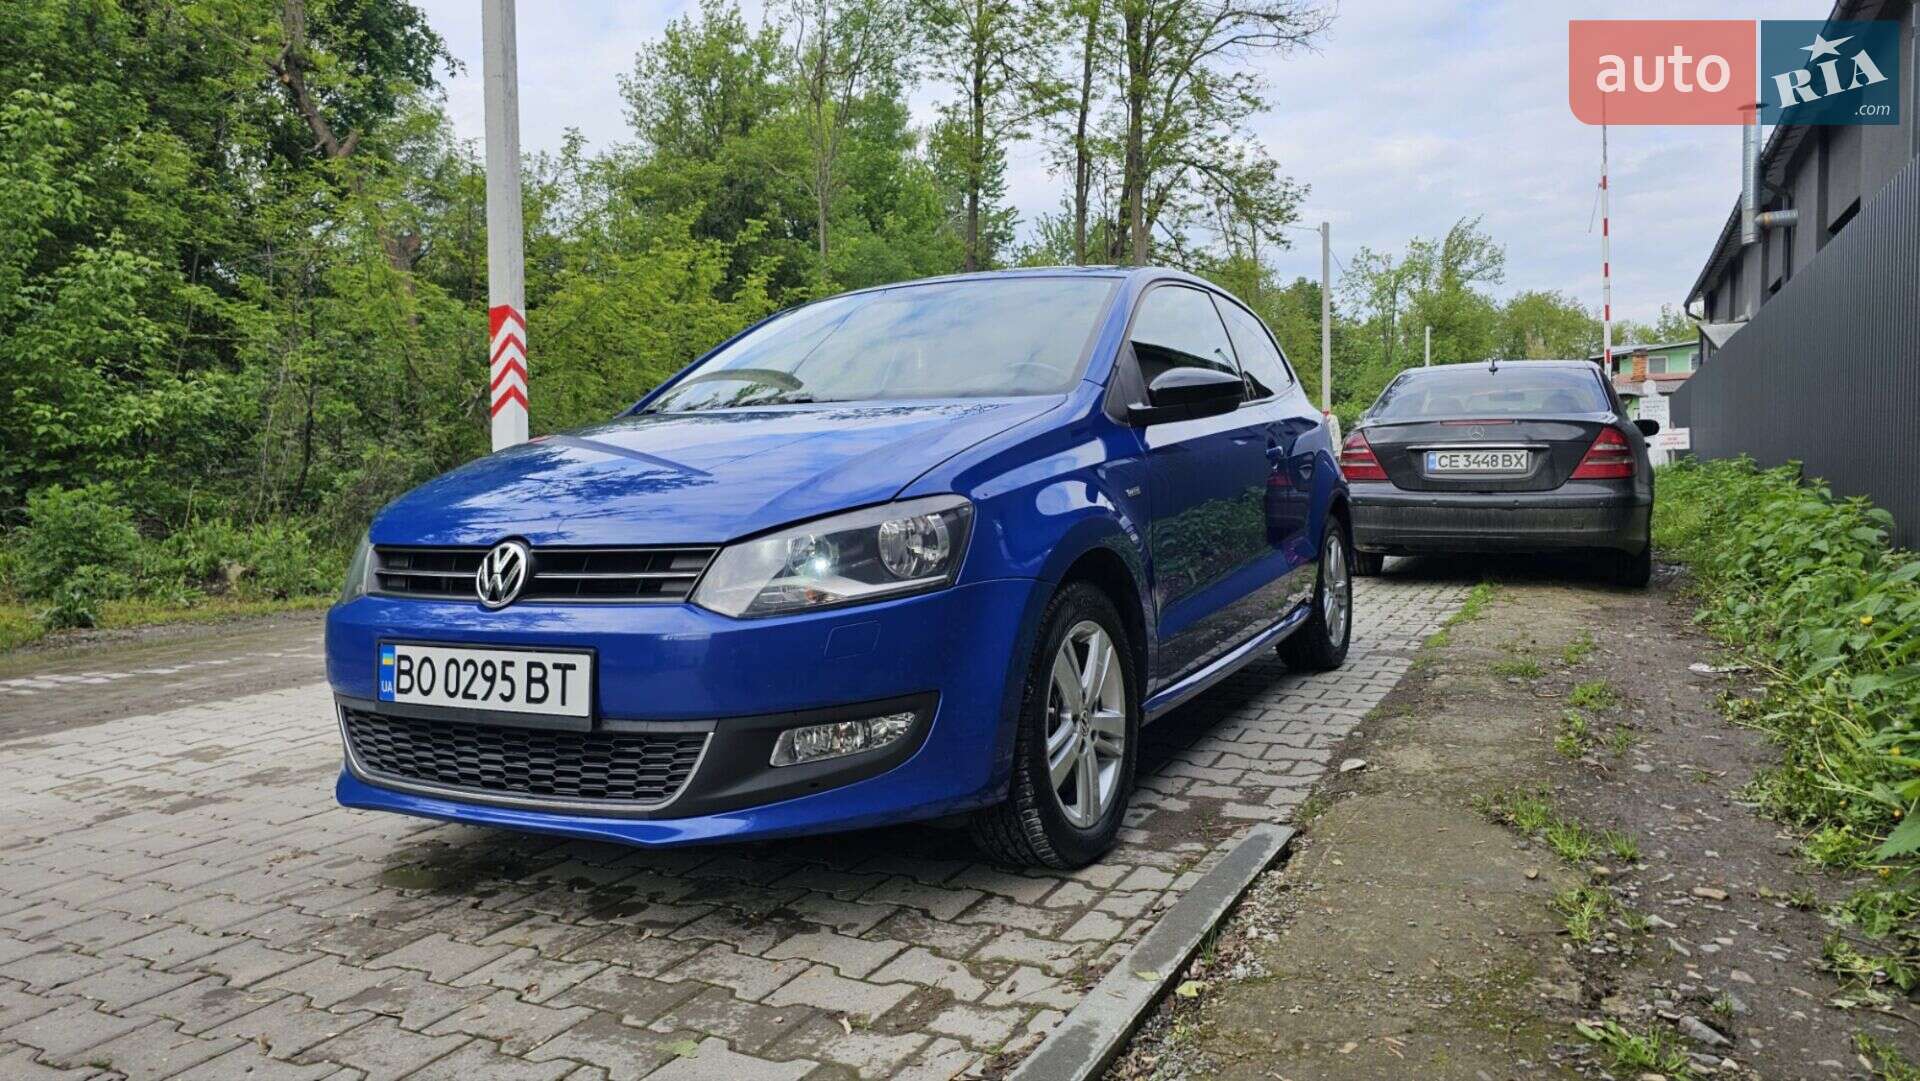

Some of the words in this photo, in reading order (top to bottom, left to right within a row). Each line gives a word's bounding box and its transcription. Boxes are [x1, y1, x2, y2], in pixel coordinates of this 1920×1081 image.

[1438, 454, 1460, 468] CE
[1463, 454, 1499, 468] 3448
[1501, 454, 1525, 468] BX
[381, 680, 393, 694] UA
[396, 654, 436, 697] BO
[444, 657, 516, 703] 0295
[525, 660, 576, 706] BT
